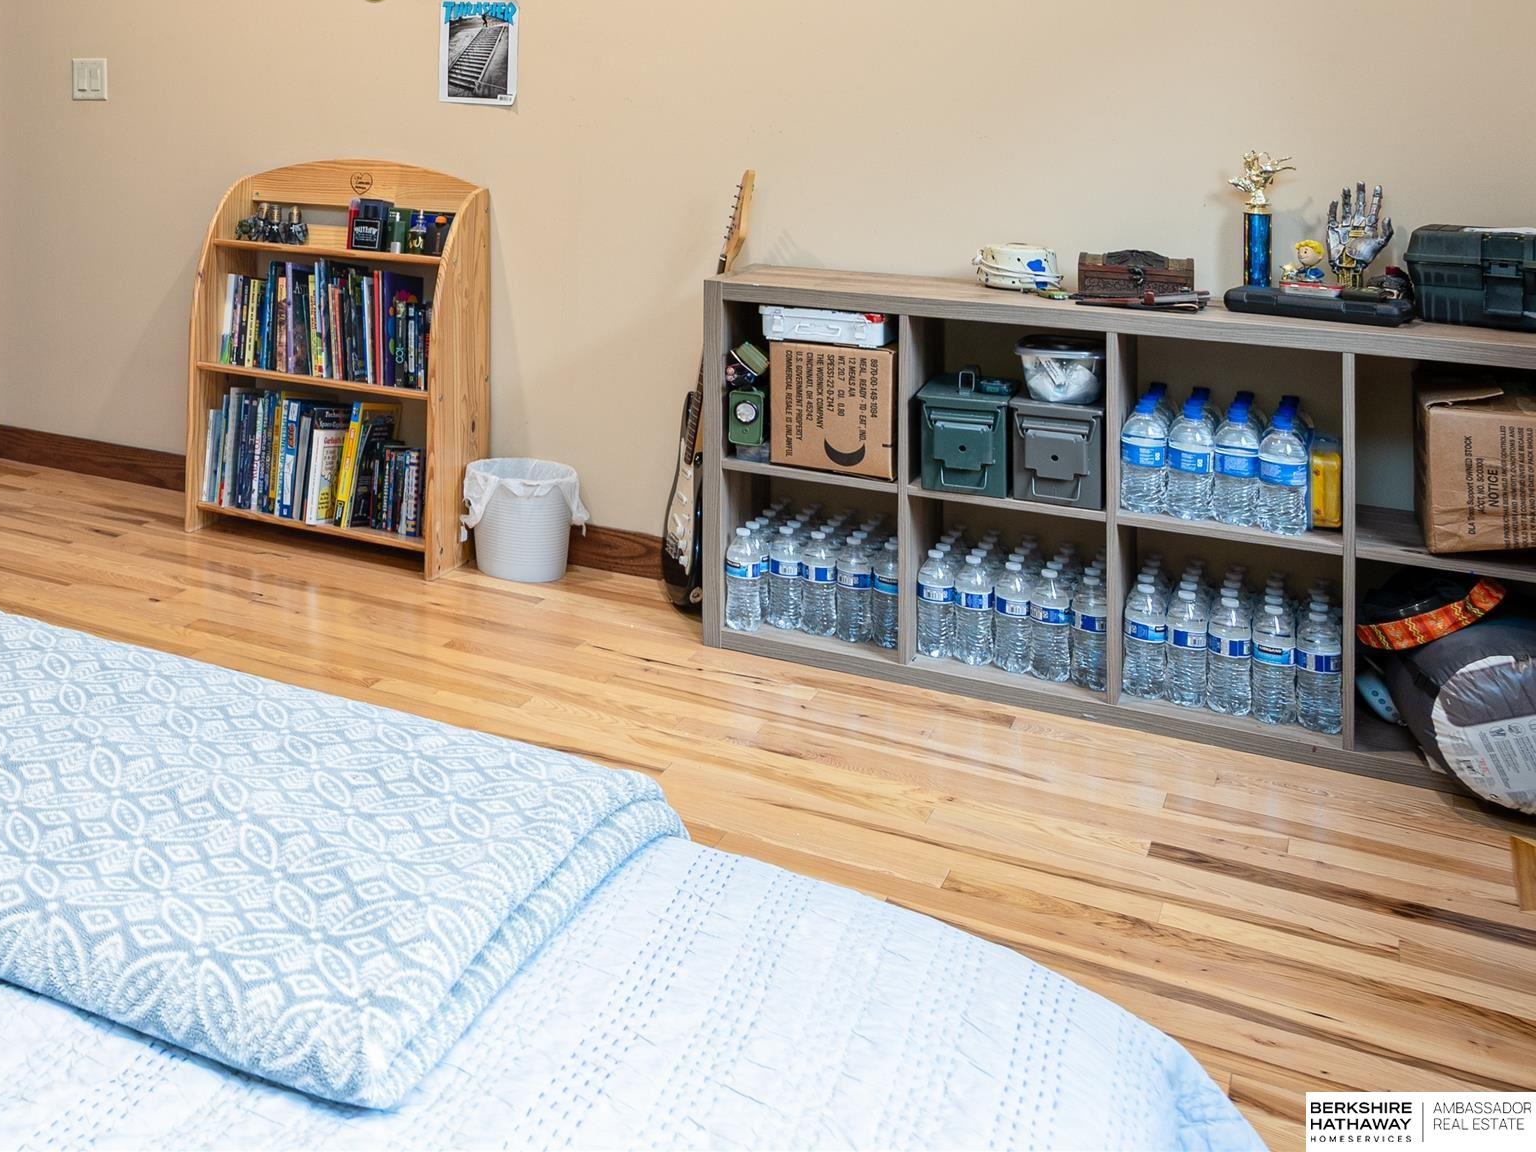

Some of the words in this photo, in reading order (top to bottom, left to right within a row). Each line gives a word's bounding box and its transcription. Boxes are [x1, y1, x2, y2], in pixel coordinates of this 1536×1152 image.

[443, 1, 517, 25] THRASHER
[806, 391, 813, 399] OH
[1464, 436, 1472, 457] STOCK
[1465, 458, 1473, 481] OWNED
[1466, 482, 1476, 505] Support
[1487, 469, 1499, 507] NOTICE
[1468, 522, 1476, 534] DLA
